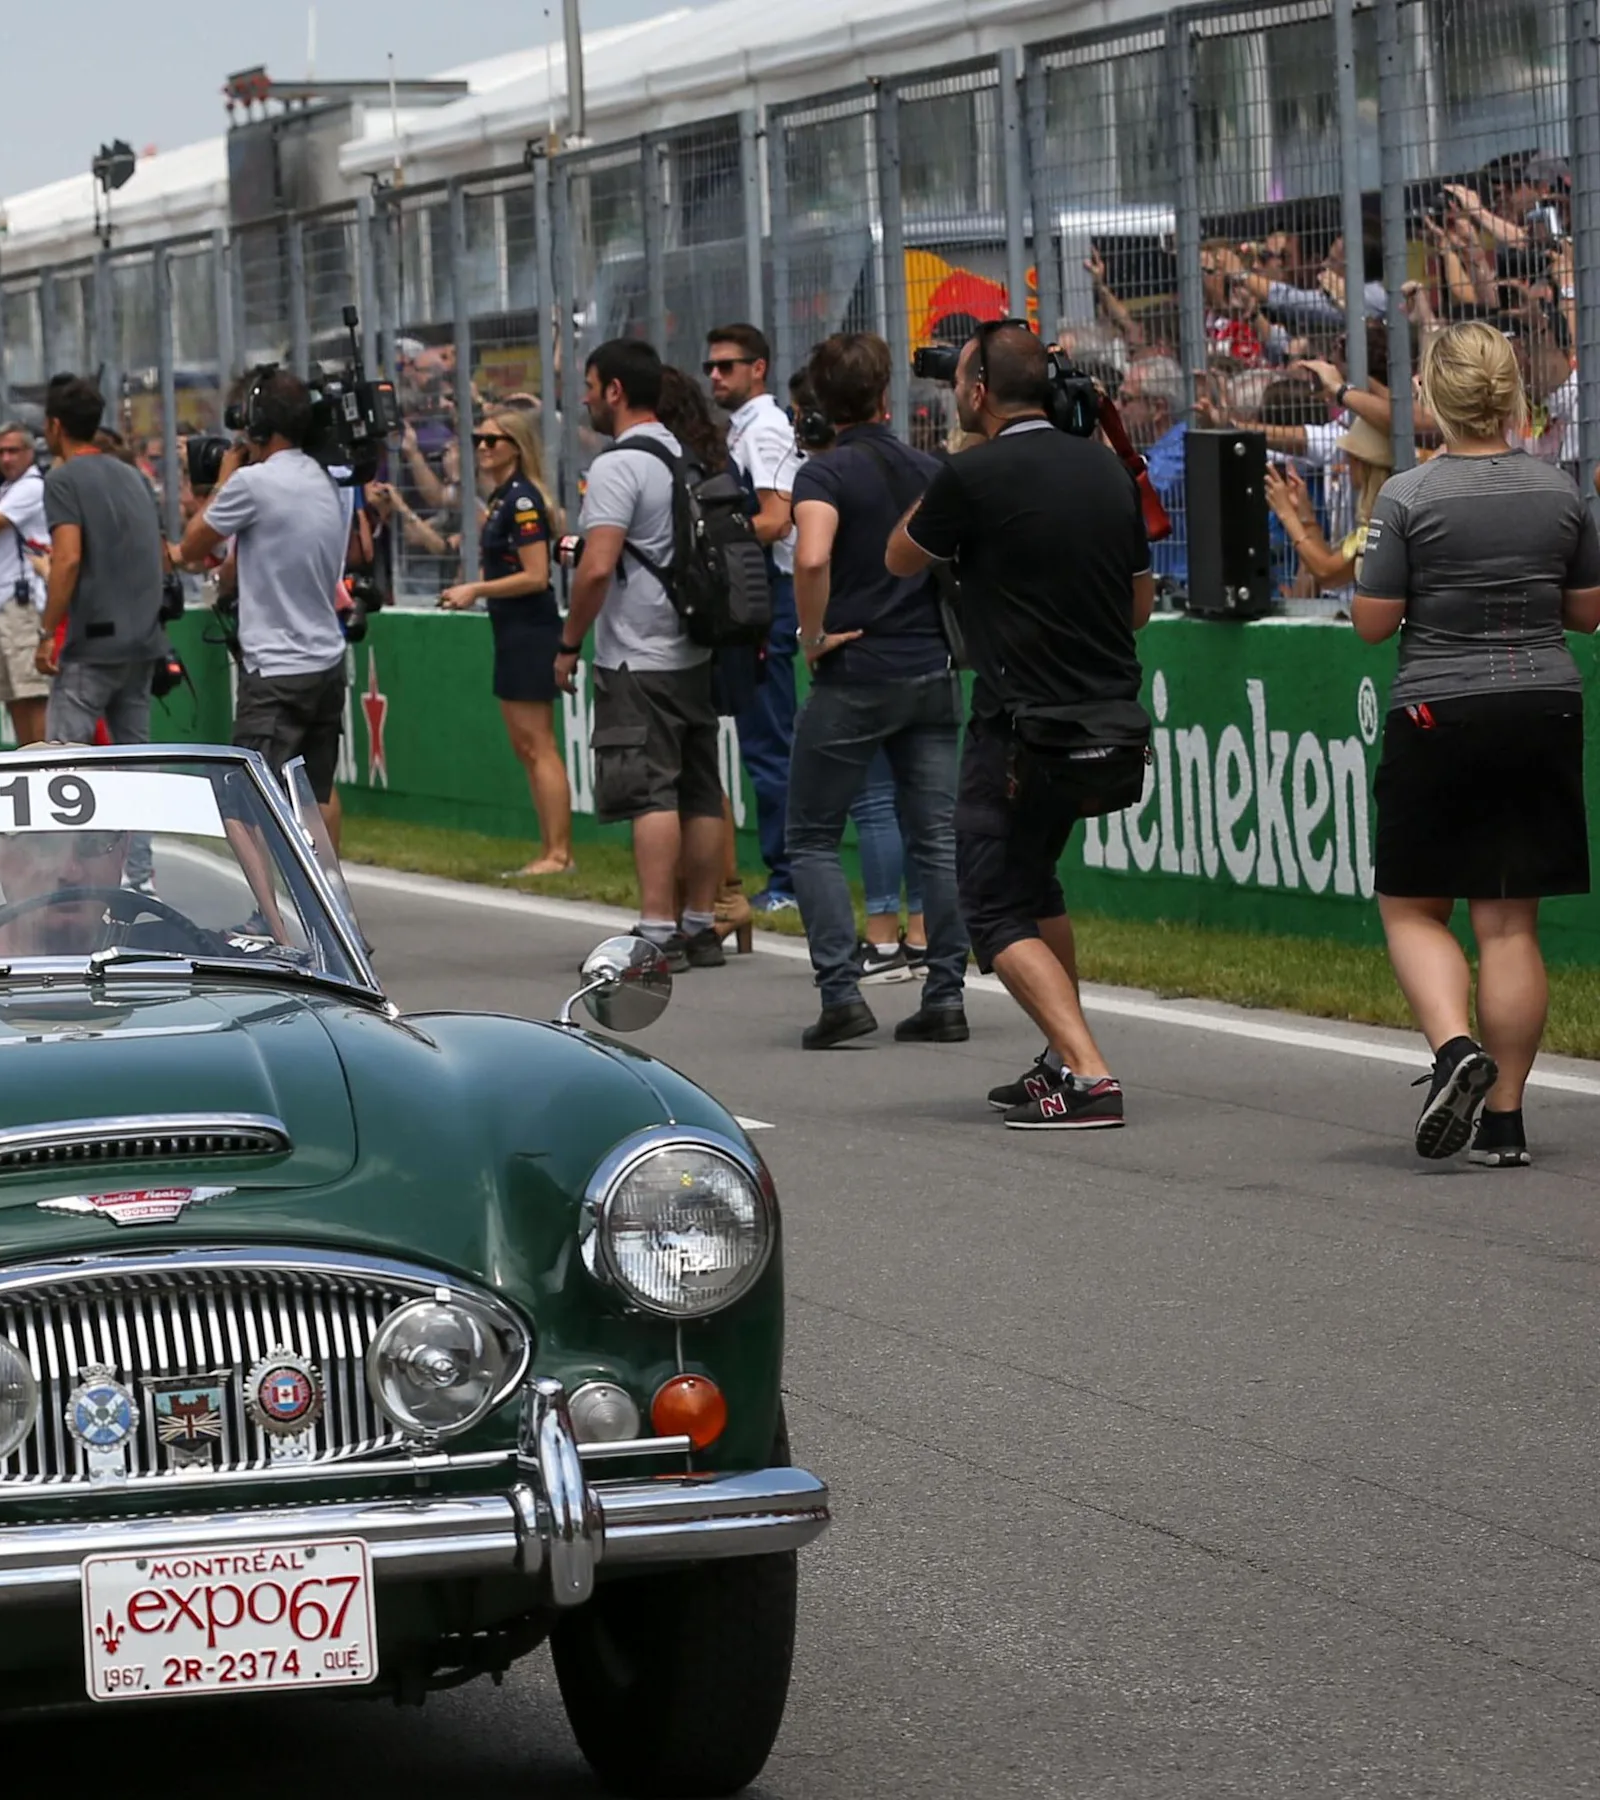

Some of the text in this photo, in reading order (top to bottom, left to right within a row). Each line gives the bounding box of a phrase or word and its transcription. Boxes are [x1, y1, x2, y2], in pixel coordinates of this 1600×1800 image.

[0, 774, 97, 826] 19
[149, 1549, 304, 1580] MONTRÉAL
[163, 1649, 300, 1687] 2R-2374
